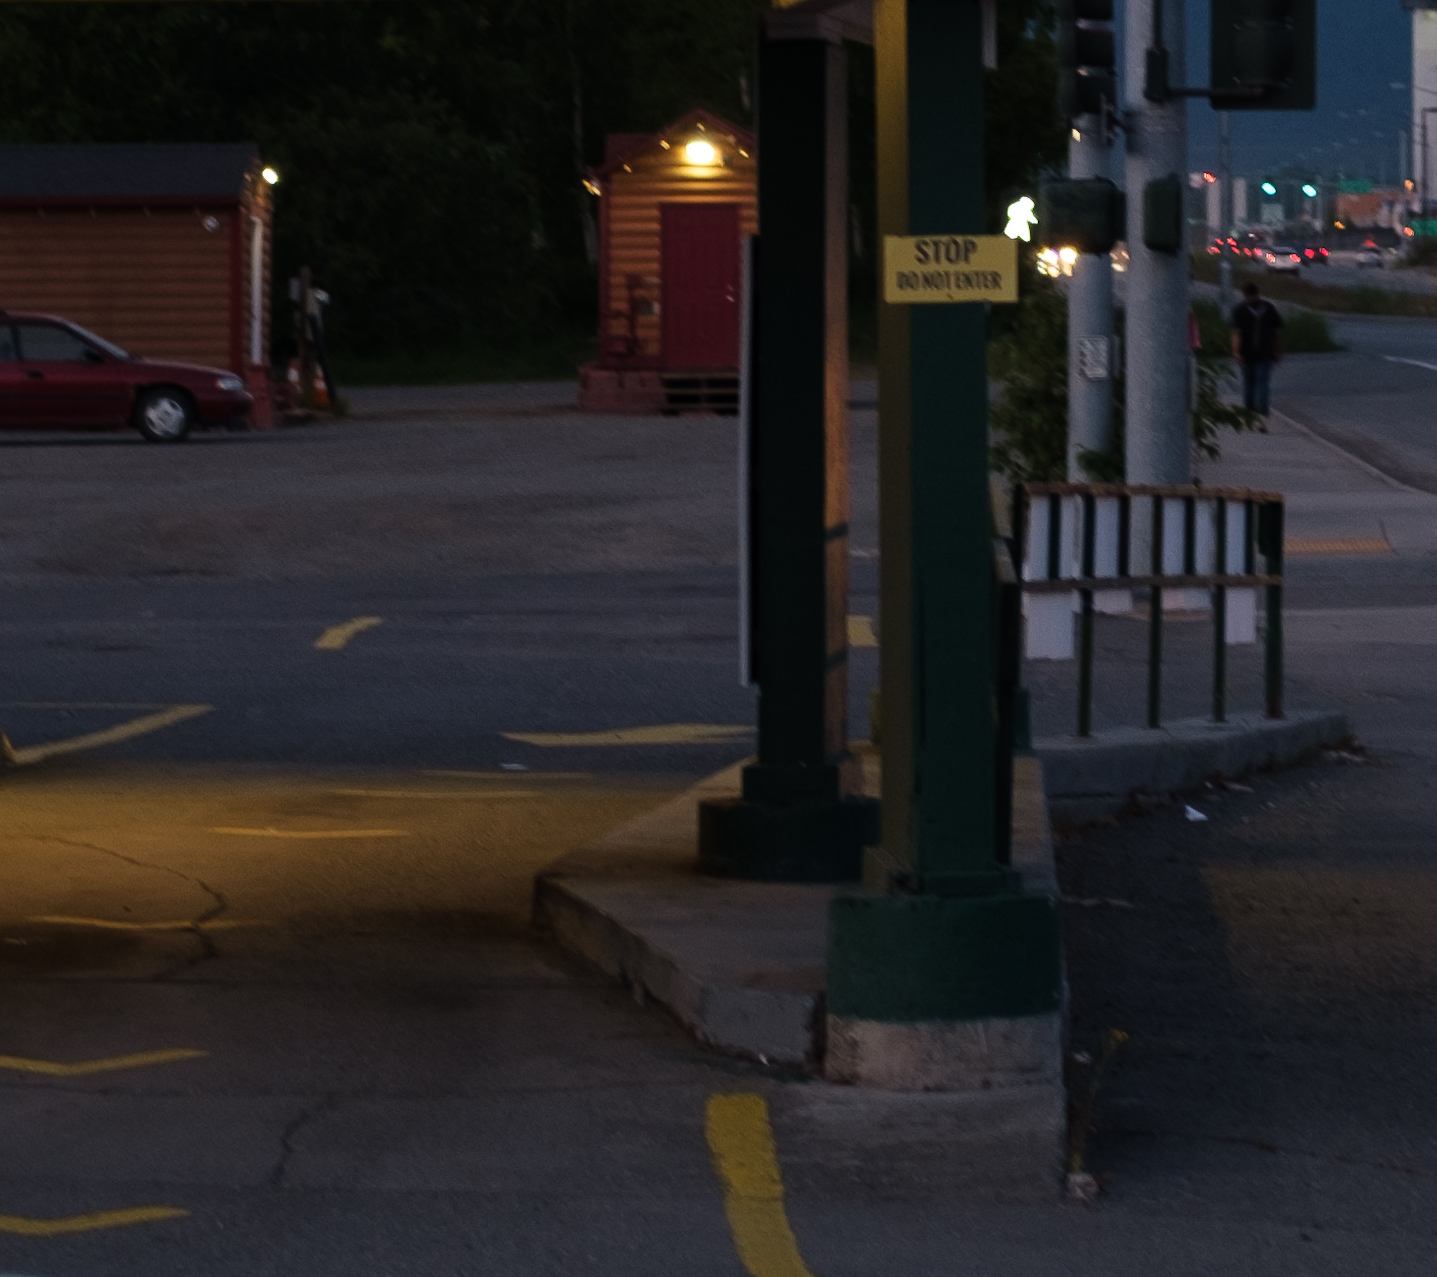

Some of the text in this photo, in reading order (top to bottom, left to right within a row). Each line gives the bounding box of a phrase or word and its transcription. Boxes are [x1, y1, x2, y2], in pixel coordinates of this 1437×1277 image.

[914, 236, 979, 265] STOP
[896, 270, 1003, 291] DO NOT ENTER
